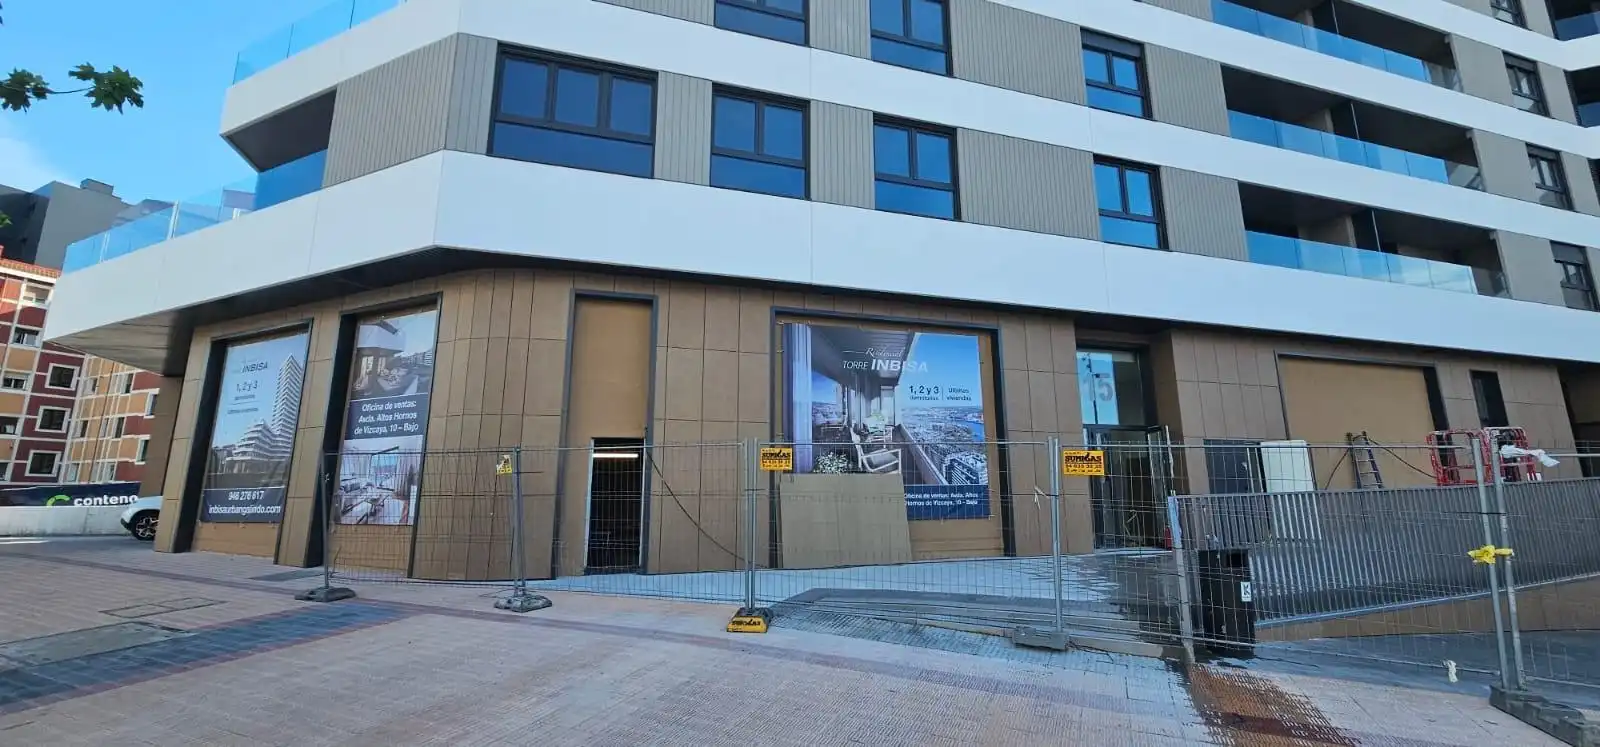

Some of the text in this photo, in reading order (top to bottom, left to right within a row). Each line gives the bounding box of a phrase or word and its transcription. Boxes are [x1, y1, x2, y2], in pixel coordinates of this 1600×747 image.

[242, 361, 268, 373] INBISA
[843, 358, 929, 373] TORRE INBISA
[919, 385, 925, 394] 2
[926, 387, 932, 396] y
[933, 385, 939, 394] 3
[1083, 373, 1114, 401] 15
[361, 400, 417, 412] Oficina de ventas:
[376, 412, 393, 422] Altos
[393, 411, 418, 421] Hornos
[354, 426, 363, 435] de
[390, 424, 398, 432] 10
[403, 422, 419, 432] Bajo
[1064, 452, 1102, 462] SUMIGAS
